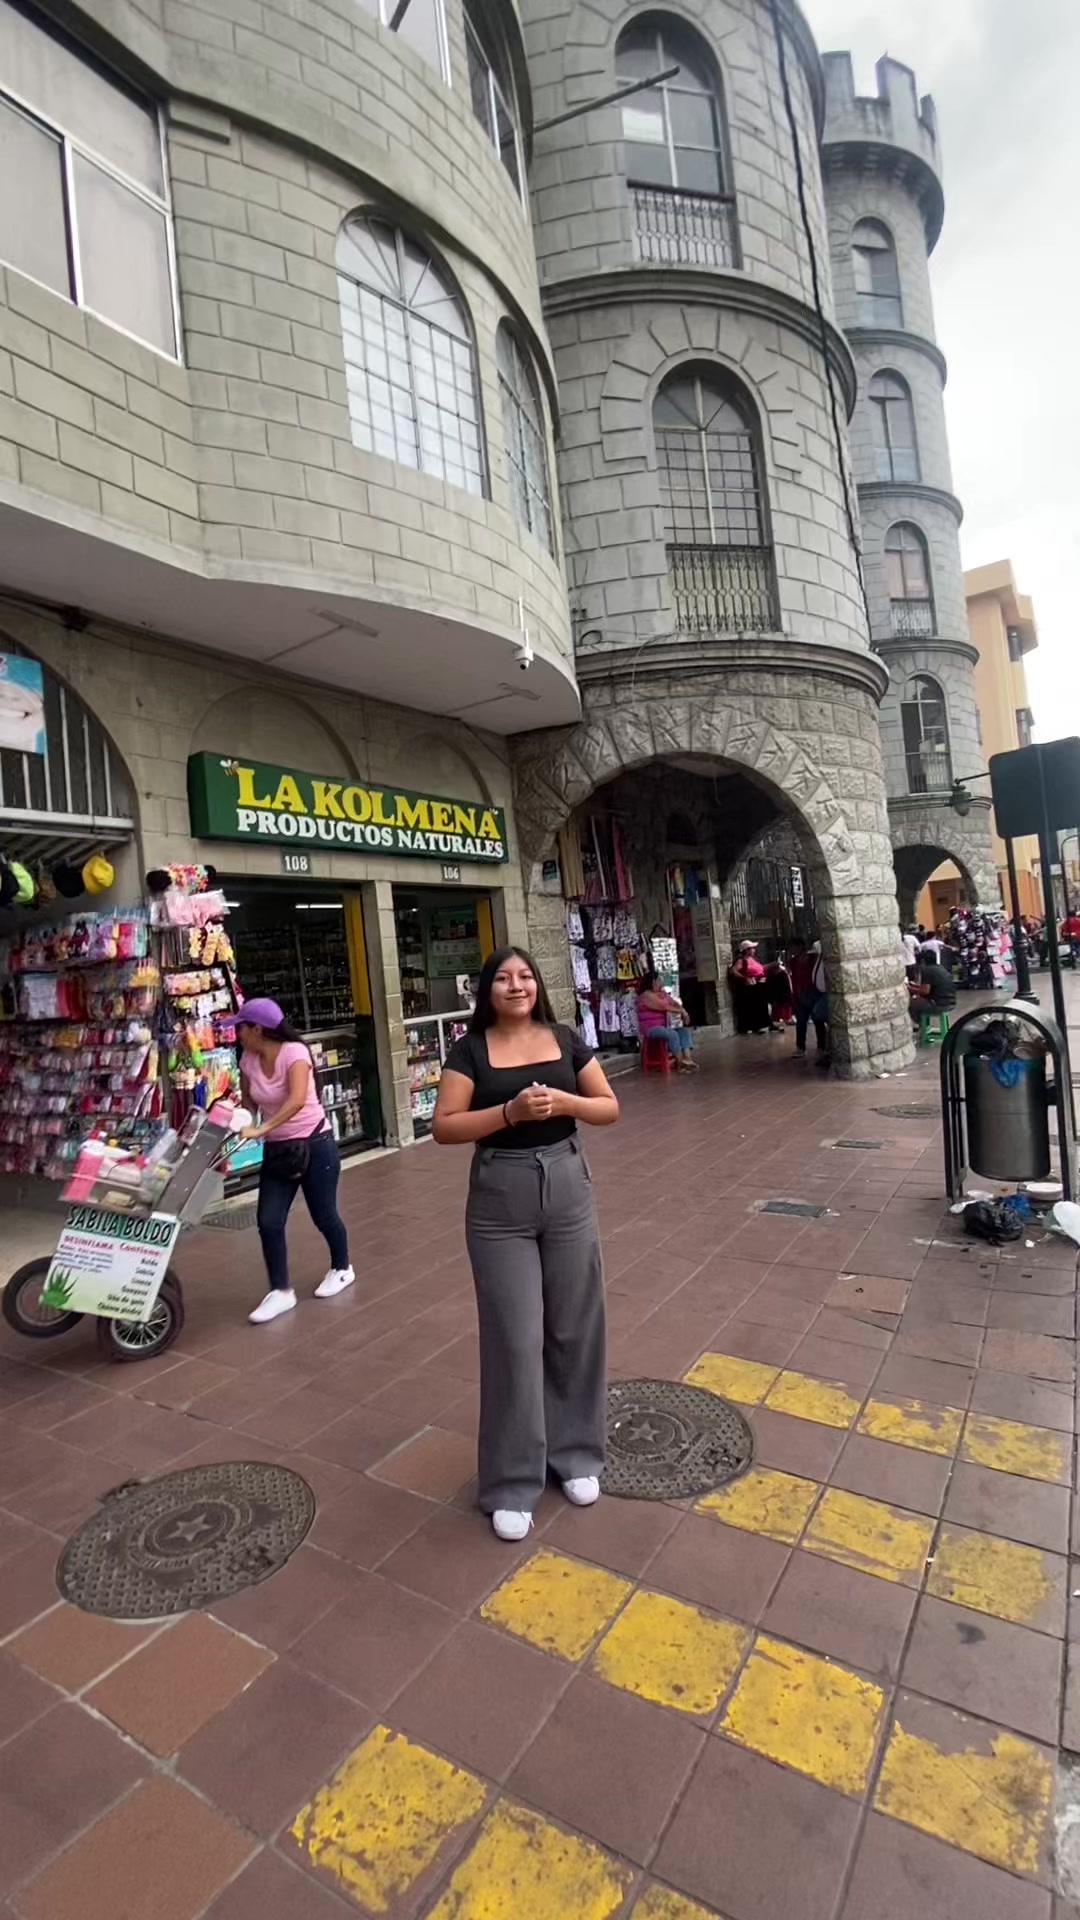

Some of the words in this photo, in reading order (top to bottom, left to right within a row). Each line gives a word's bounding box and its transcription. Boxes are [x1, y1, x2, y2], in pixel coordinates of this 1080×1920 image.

[236, 767, 308, 813] LA
[312, 780, 501, 840] KOLMENA
[236, 808, 393, 846] PRODUCTOS
[397, 829, 504, 858] NATURALES
[285, 855, 308, 871] 108
[67, 1206, 120, 1235] SABILA
[123, 1217, 172, 1243] BOLDO
